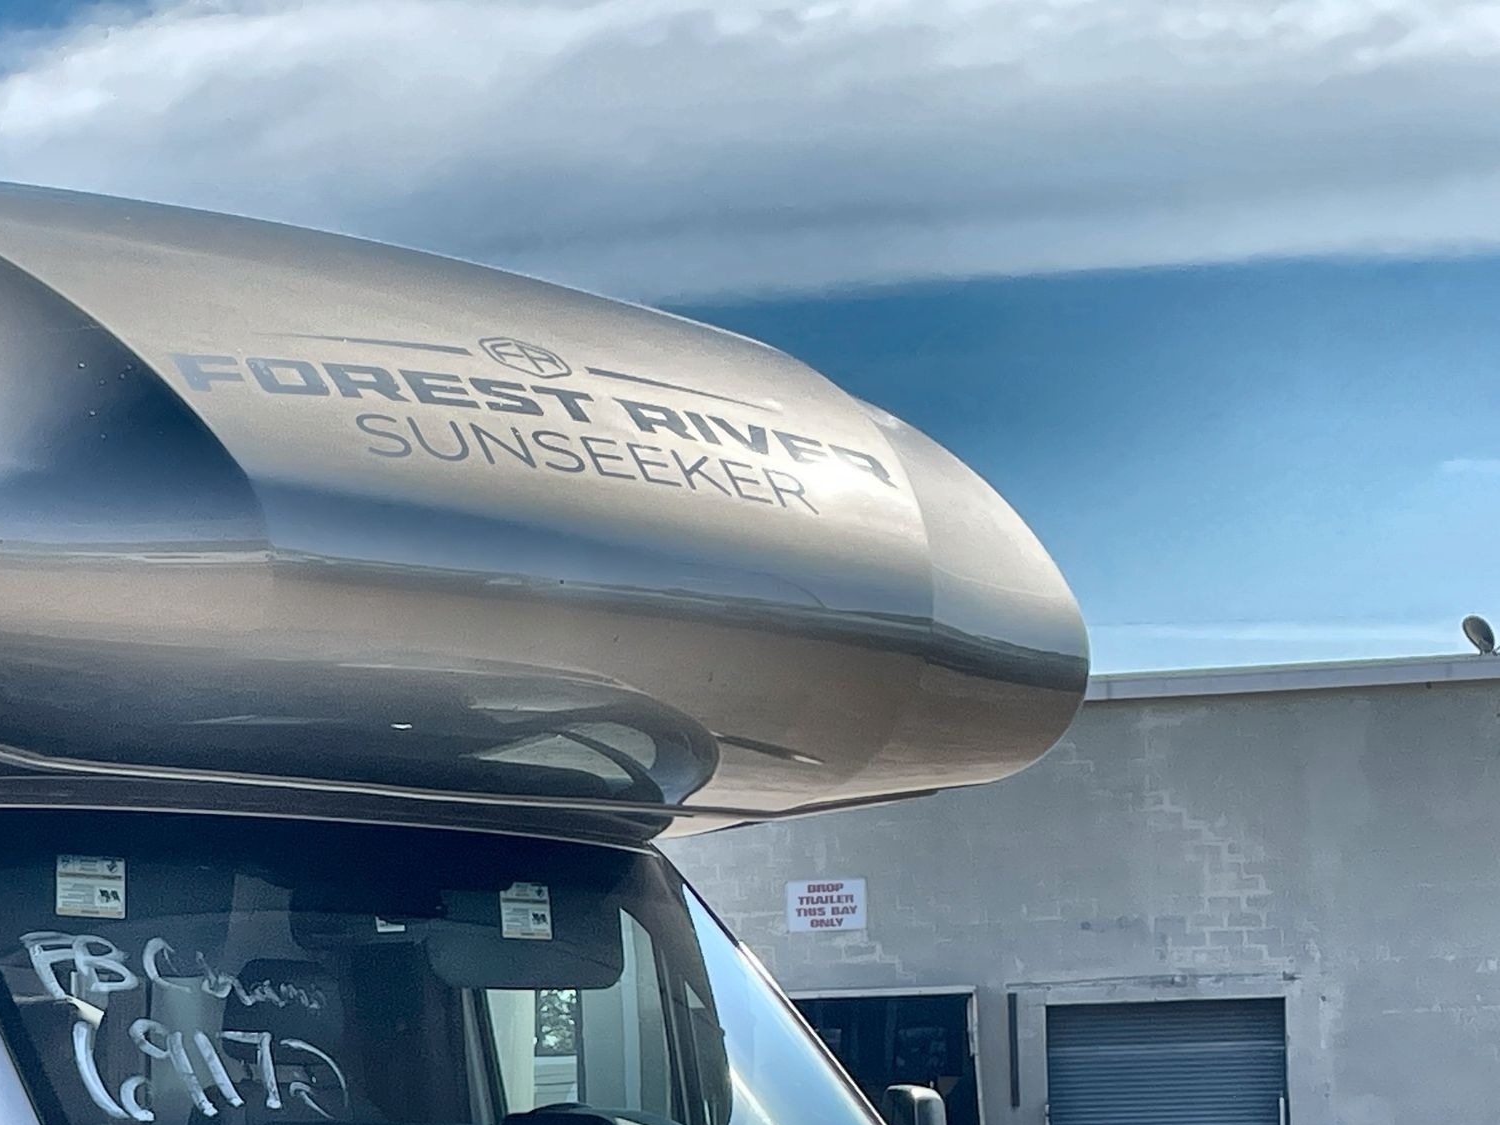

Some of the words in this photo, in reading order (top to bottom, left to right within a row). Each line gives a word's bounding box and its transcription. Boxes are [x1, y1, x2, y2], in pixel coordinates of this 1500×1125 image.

[170, 352, 595, 424] FOREST
[611, 396, 898, 490] RIVER
[355, 412, 820, 516] SUNSEEKER
[807, 883, 844, 893] DROP
[798, 894, 855, 905] TRAILER
[796, 906, 826, 917] THIS
[831, 905, 858, 916] BAY
[810, 918, 844, 928] ONLY
